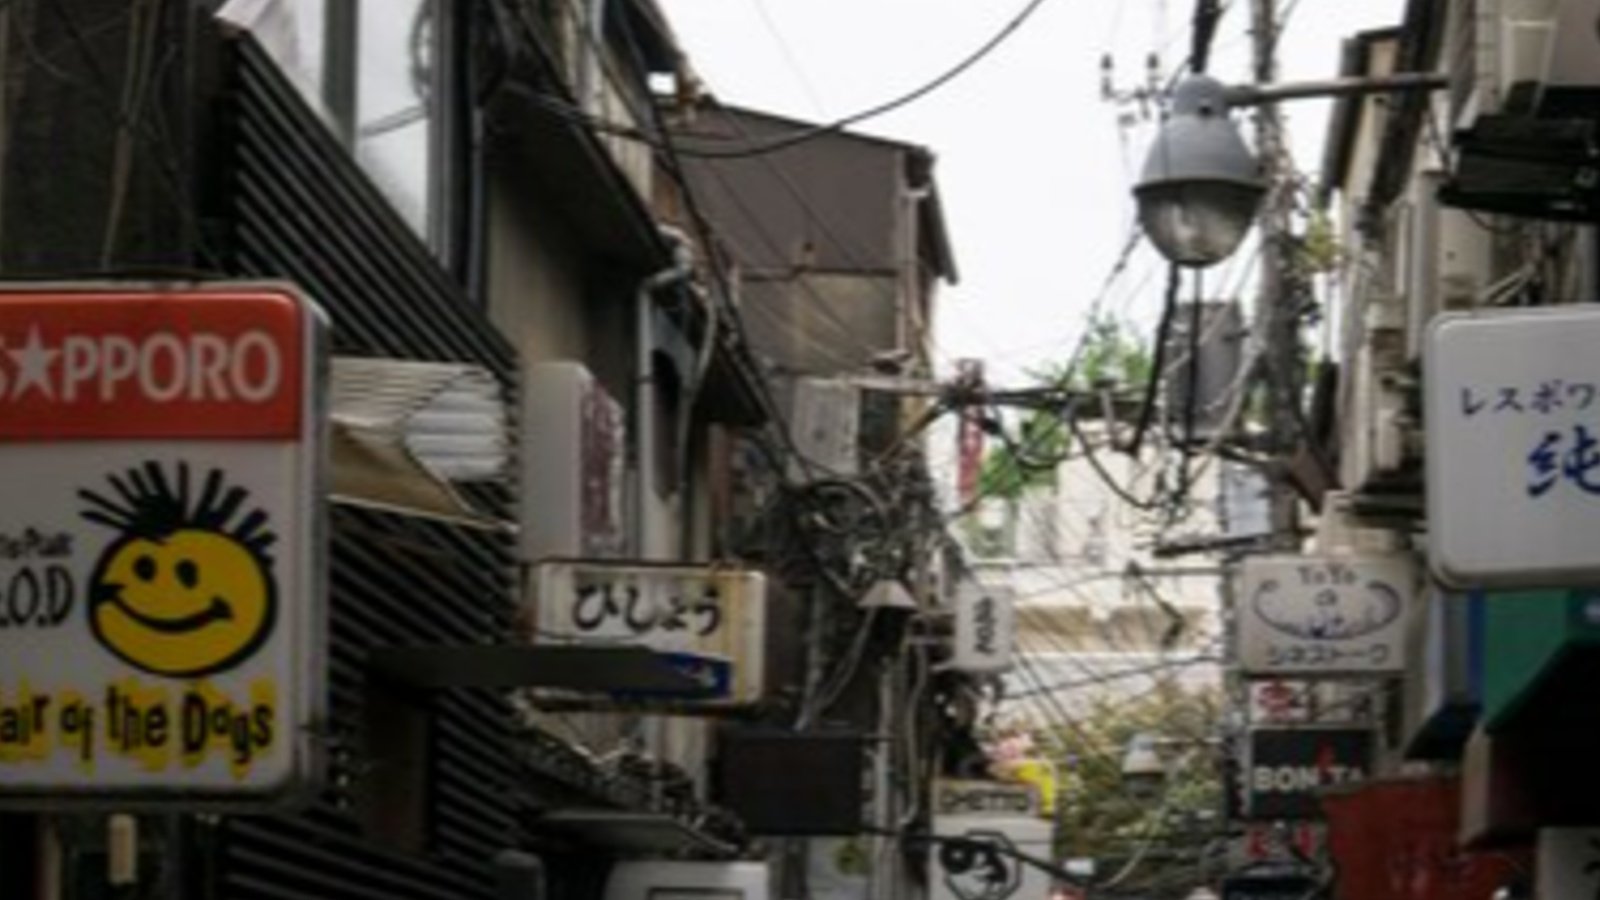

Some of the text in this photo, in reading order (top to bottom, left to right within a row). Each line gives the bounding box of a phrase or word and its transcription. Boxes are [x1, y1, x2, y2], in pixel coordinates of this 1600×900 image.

[0, 324, 281, 401] PPORO
[573, 585, 721, 637] ひしょう
[107, 687, 168, 750] the
[183, 694, 273, 764] Dogs
